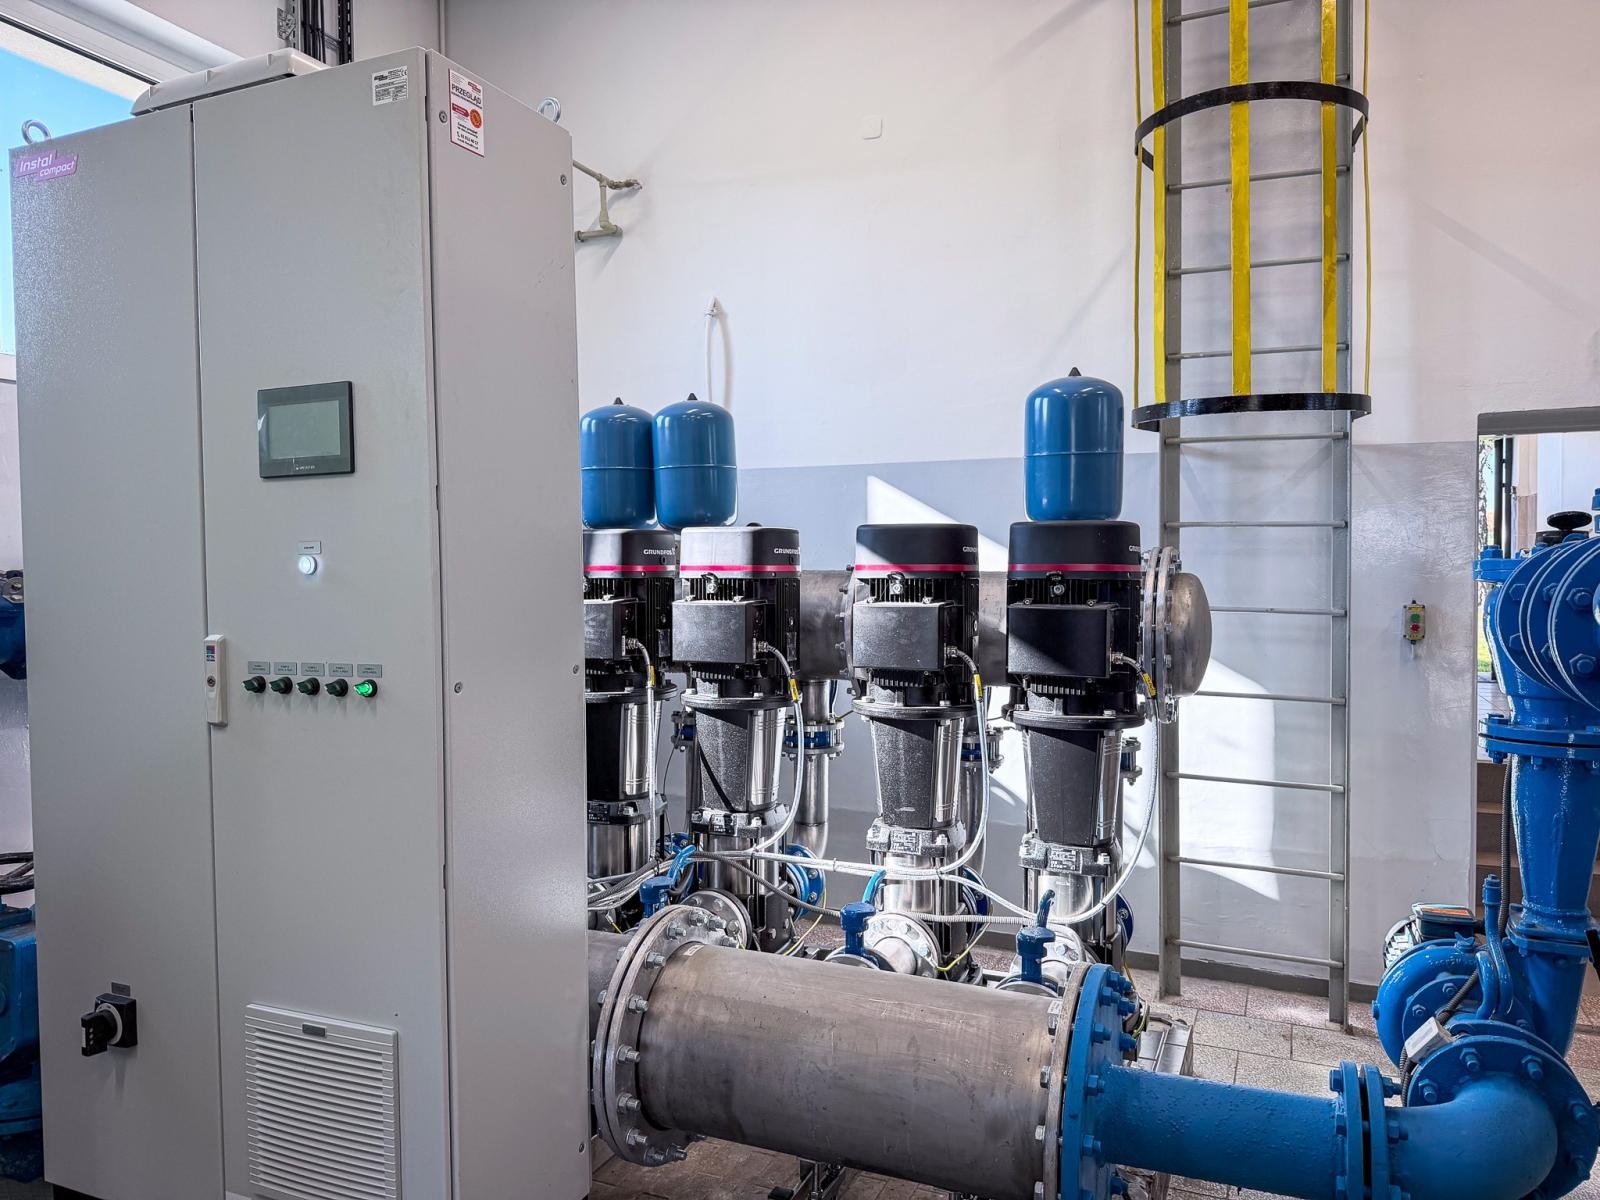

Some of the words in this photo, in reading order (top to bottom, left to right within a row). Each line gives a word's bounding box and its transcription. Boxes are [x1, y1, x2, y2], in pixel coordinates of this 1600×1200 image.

[451, 83, 481, 104] PRZEGLĄD
[20, 154, 53, 173] Instal
[40, 161, 75, 176] compact
